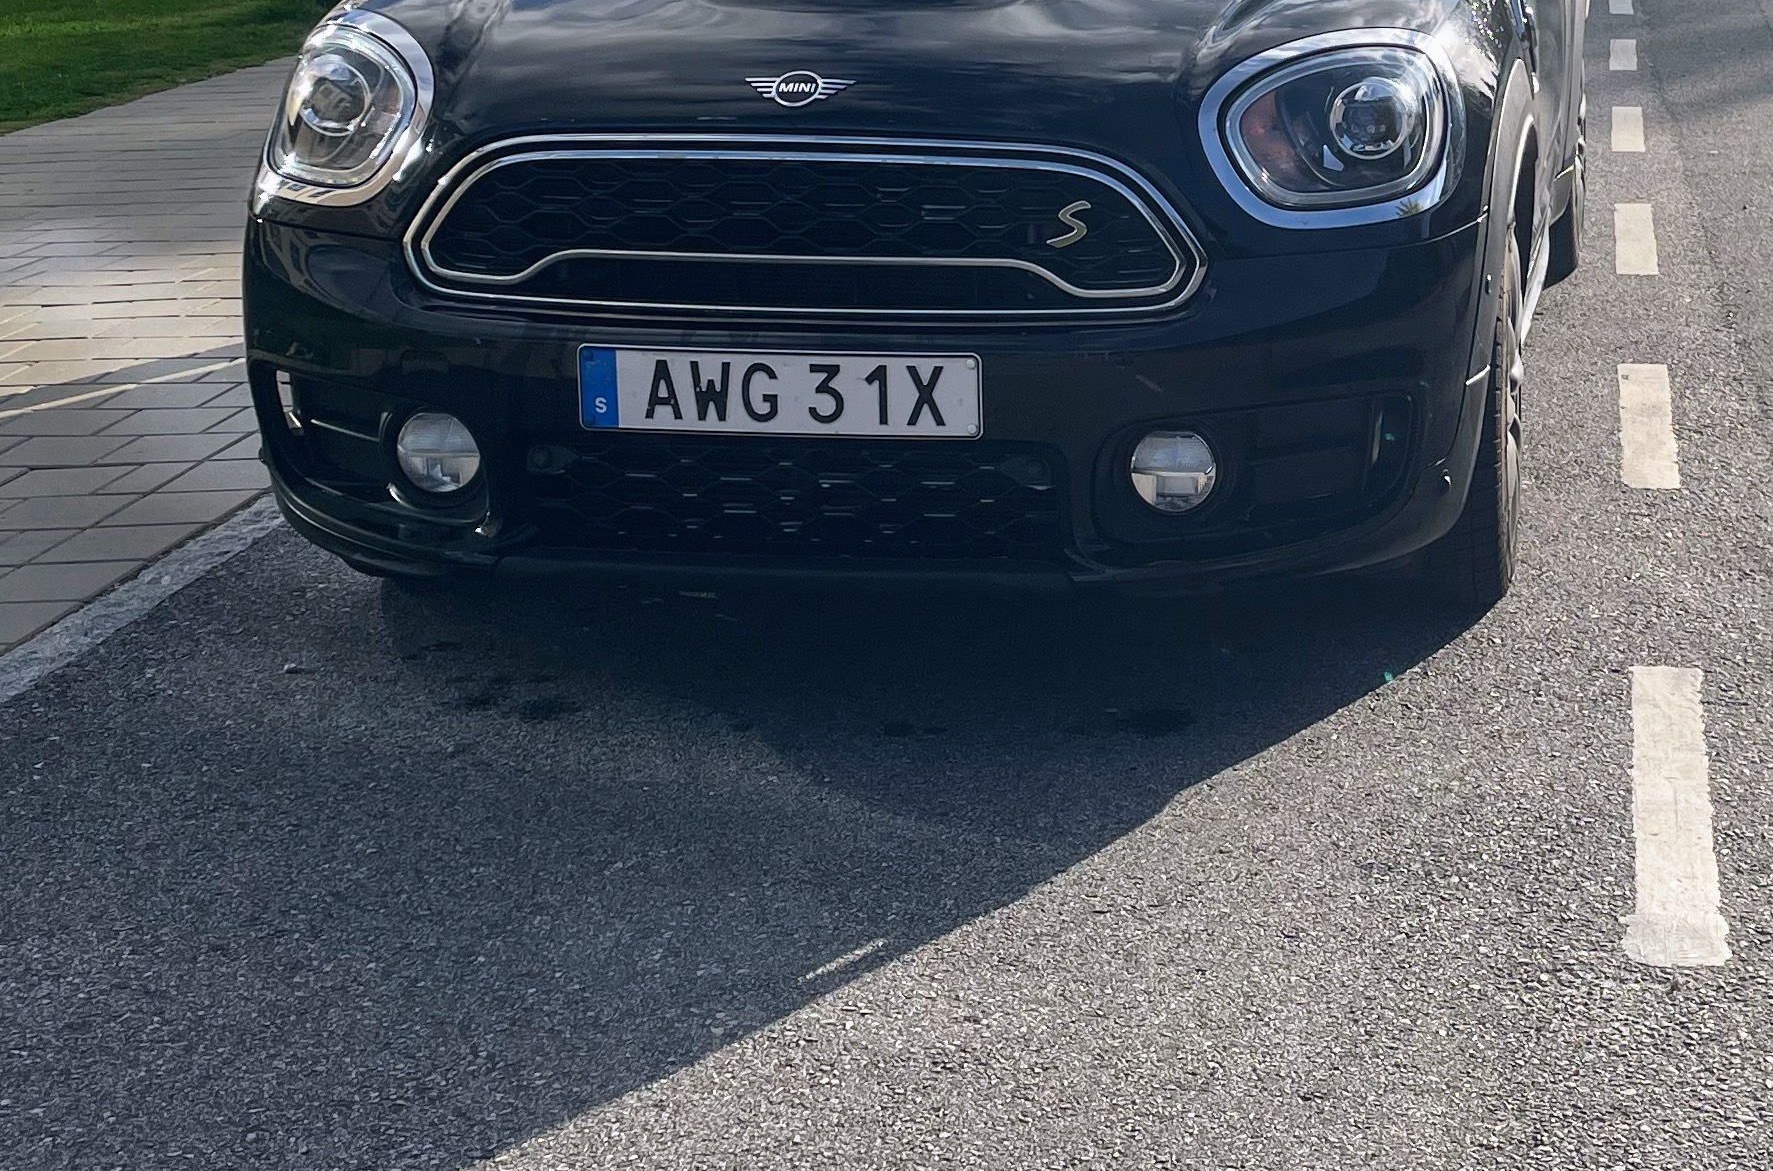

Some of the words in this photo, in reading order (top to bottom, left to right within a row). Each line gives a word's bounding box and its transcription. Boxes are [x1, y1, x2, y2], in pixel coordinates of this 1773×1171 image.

[778, 82, 816, 93] MINI
[1046, 199, 1091, 248] S
[595, 397, 608, 414] S
[645, 359, 779, 422] AWG
[808, 363, 946, 426] 31X
